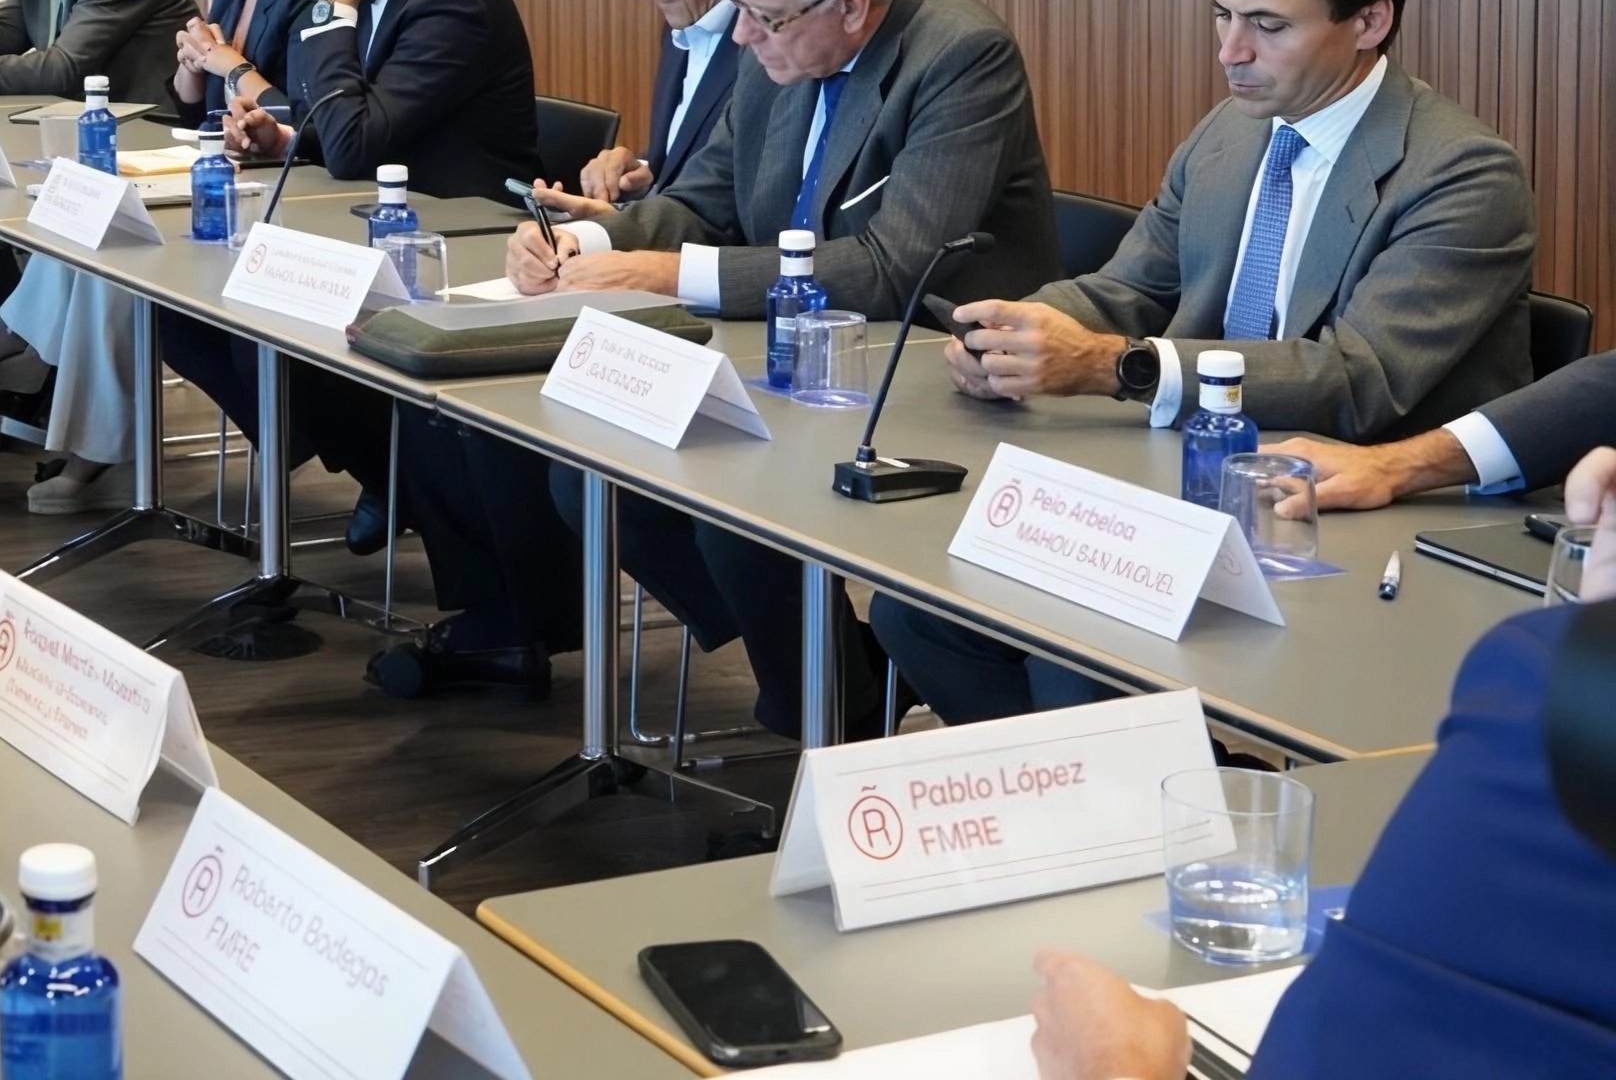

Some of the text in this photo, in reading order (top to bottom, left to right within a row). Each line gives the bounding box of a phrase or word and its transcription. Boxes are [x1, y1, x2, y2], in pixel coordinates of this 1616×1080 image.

[1031, 486, 1137, 543] Peio Arbeloa
[1015, 522, 1176, 597] MAHOU SAN MIGUEL
[908, 759, 1087, 811] Pablo López
[918, 816, 1003, 856] FMRE
[230, 864, 391, 997] Roberto Bodegas
